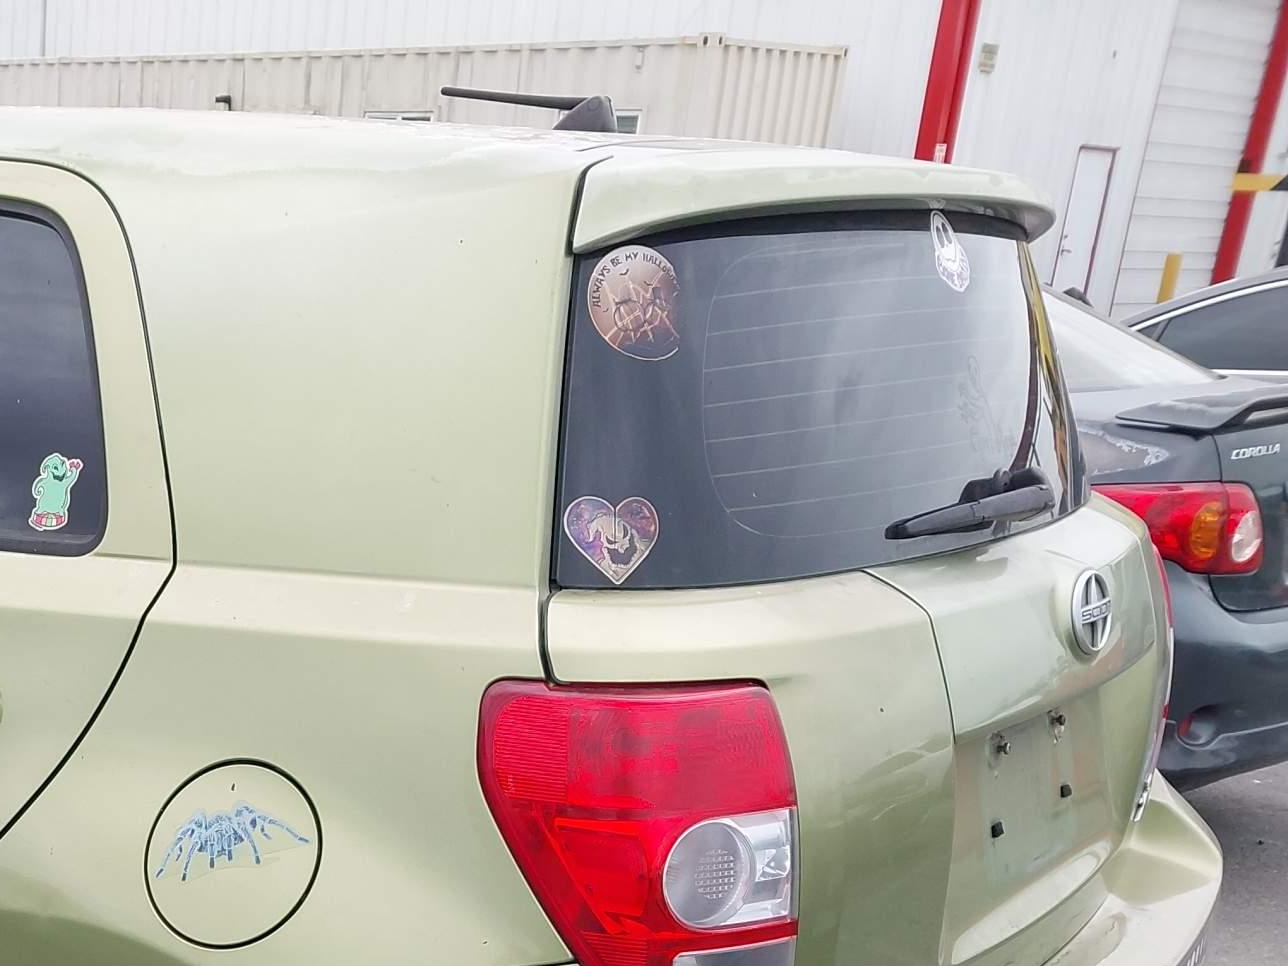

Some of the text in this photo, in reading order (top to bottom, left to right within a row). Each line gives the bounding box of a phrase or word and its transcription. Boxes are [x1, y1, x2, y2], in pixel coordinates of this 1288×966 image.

[592, 265, 611, 308] ALWAYS
[610, 255, 623, 267] BE
[625, 252, 638, 262] MY
[1230, 443, 1281, 460] COROLLA
